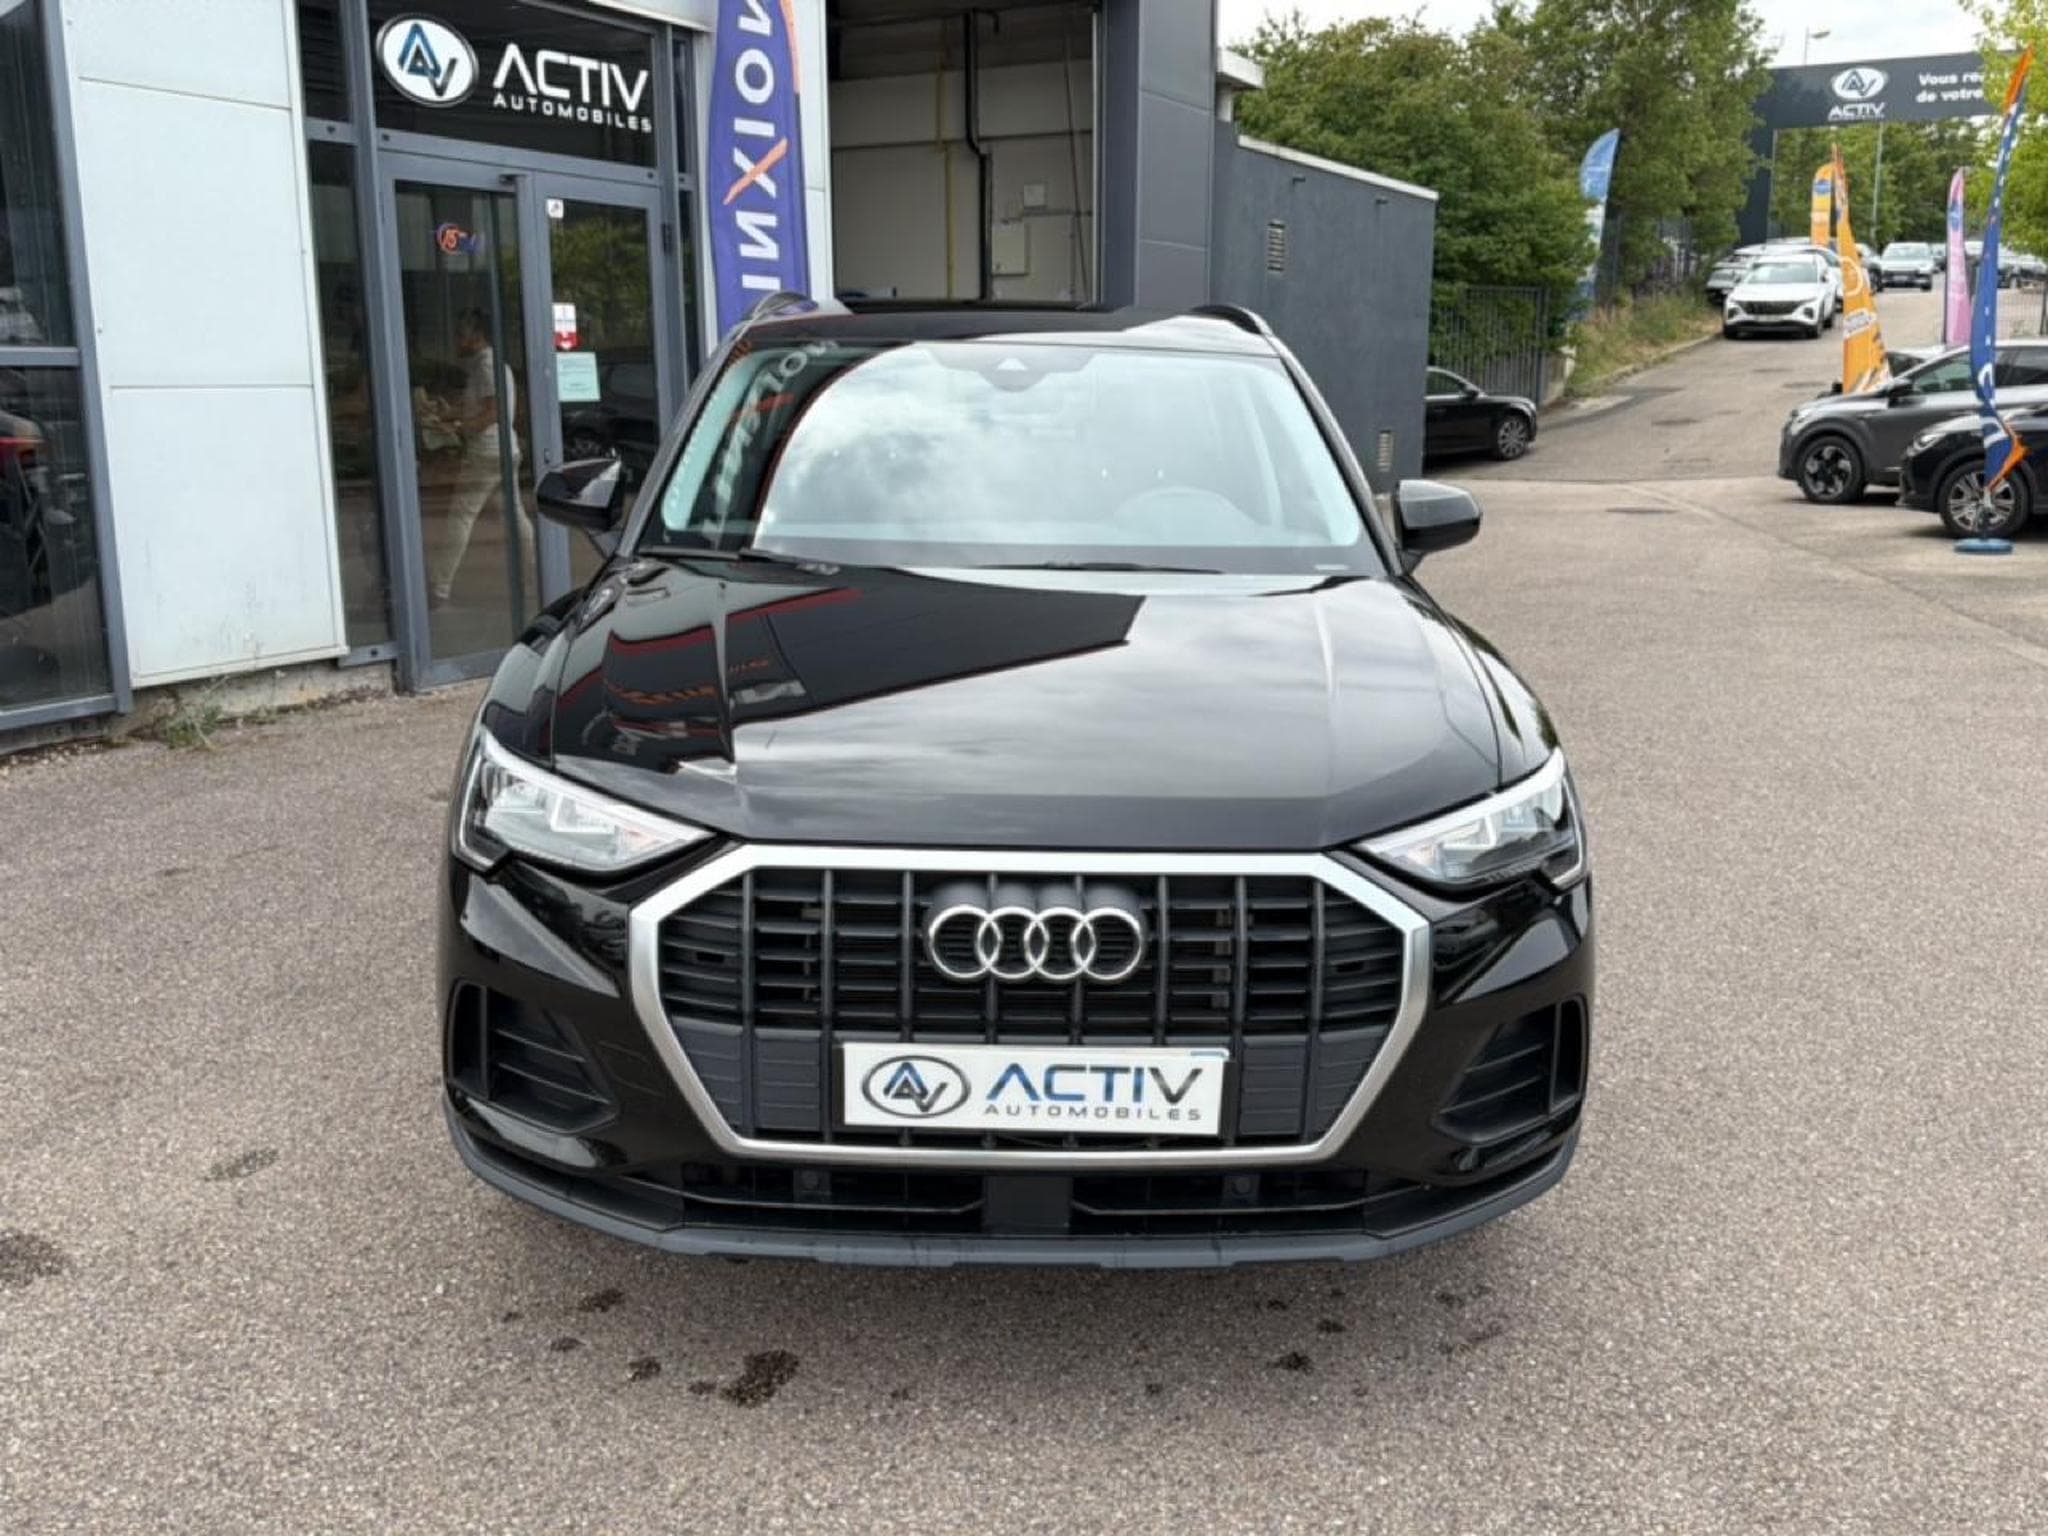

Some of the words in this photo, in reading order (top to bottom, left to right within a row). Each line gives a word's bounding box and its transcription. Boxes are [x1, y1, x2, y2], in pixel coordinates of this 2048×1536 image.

[492, 42, 650, 112] ACTIV
[1918, 72, 1958, 86] Vous
[1916, 89, 1937, 103] de
[493, 93, 652, 133] AUTOMOBILES
[1828, 101, 1885, 119] ACTIV
[985, 1062, 1204, 1102] ACTIV
[984, 1103, 1202, 1122] AUTOMOBILES
